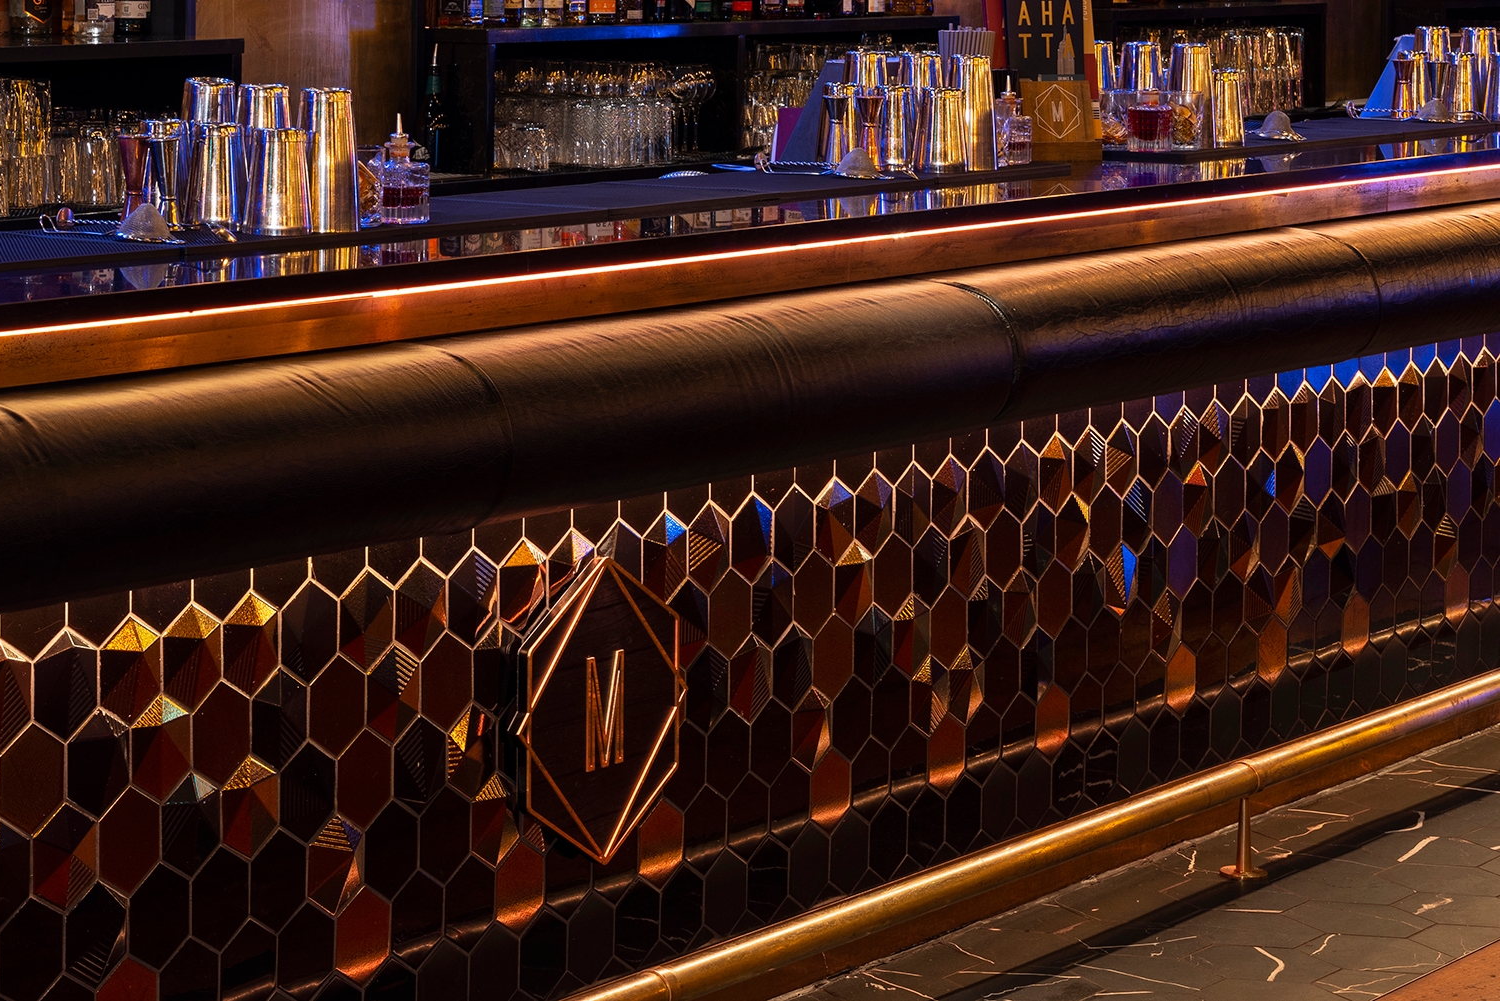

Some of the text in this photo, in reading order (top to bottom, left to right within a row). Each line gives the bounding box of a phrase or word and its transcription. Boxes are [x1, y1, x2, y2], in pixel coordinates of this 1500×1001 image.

[1017, 0, 1075, 26] AHA
[1018, 33, 1075, 59] TTA
[586, 649, 624, 773] M
